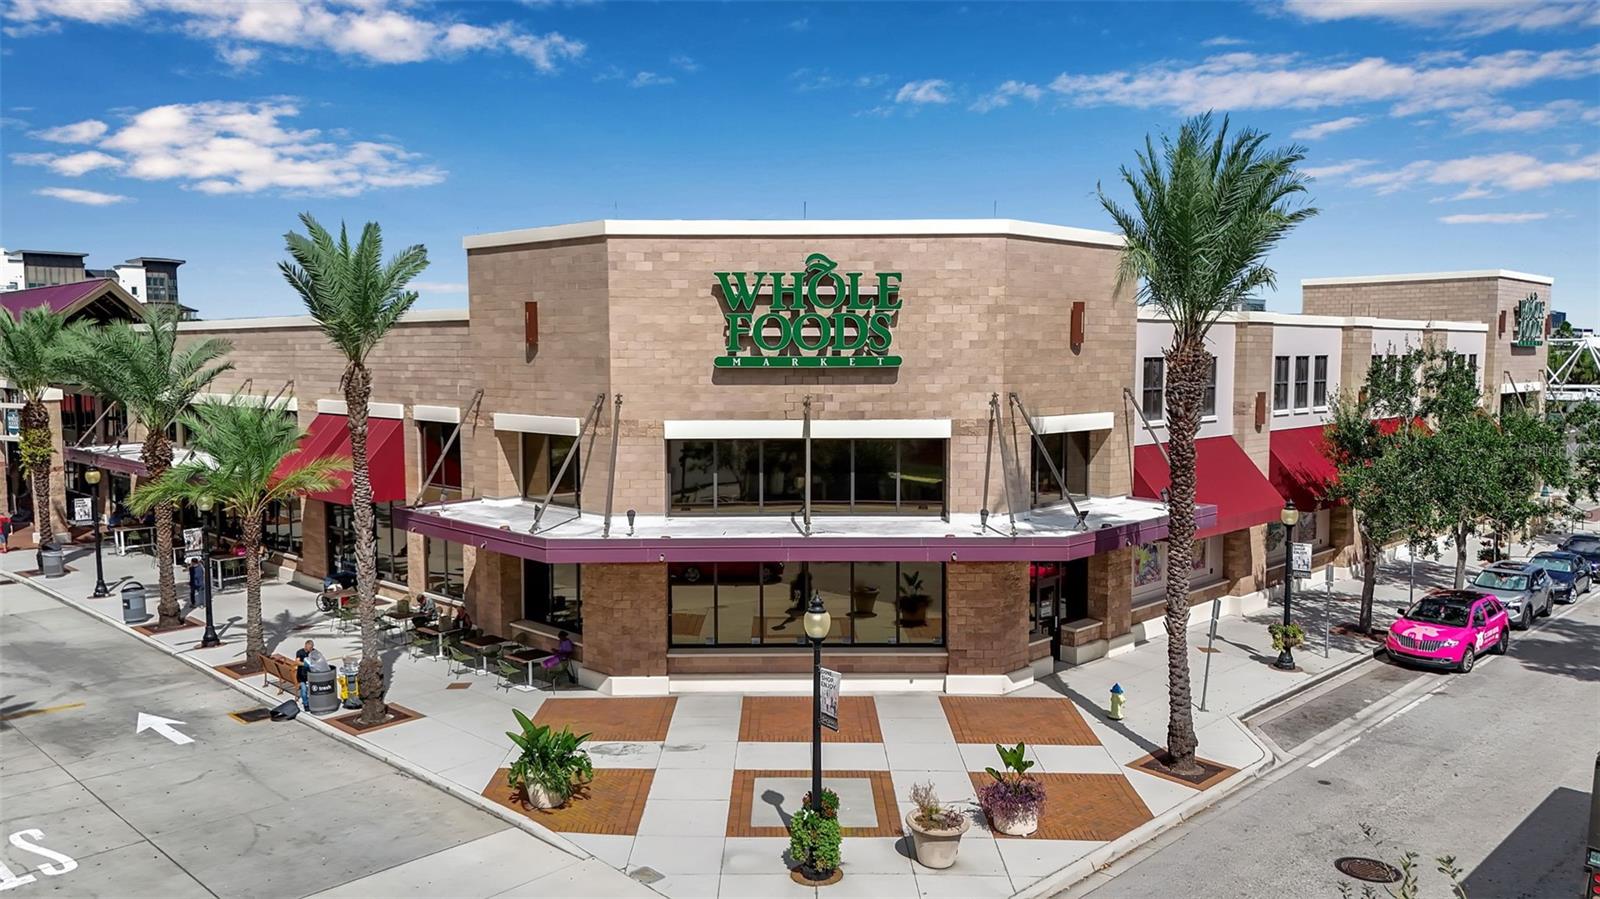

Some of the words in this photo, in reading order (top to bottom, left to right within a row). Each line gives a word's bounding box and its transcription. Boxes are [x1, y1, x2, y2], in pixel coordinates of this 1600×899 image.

[713, 268, 904, 311] WHOLE
[725, 312, 894, 352] FOODS
[732, 357, 886, 367] MARKET
